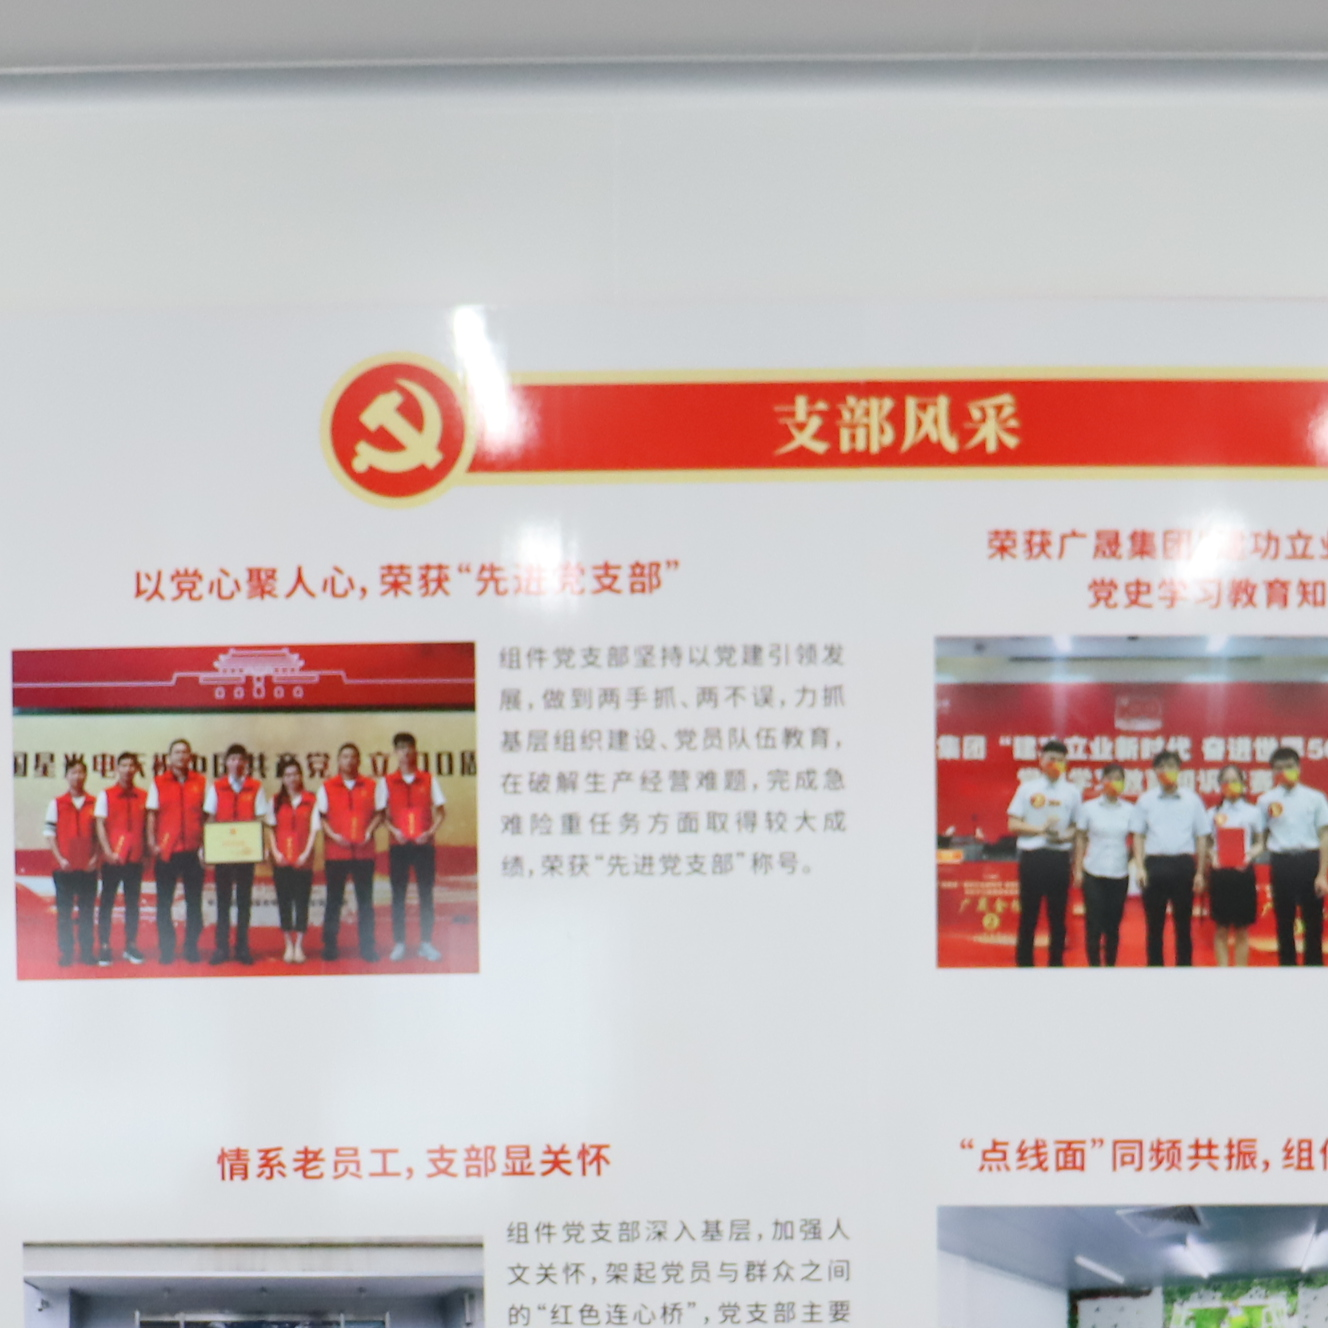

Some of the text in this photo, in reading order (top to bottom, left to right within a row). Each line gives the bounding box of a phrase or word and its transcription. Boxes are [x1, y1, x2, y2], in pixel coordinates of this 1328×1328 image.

[773, 393, 1022, 456] 支部风采
[216, 1142, 611, 1182] 情系老员工，支部显关怀
[507, 1219, 851, 1245] 组件党支部深入基层，加强人
[508, 1260, 851, 1286] 文关怀，架起党员与群众之间
